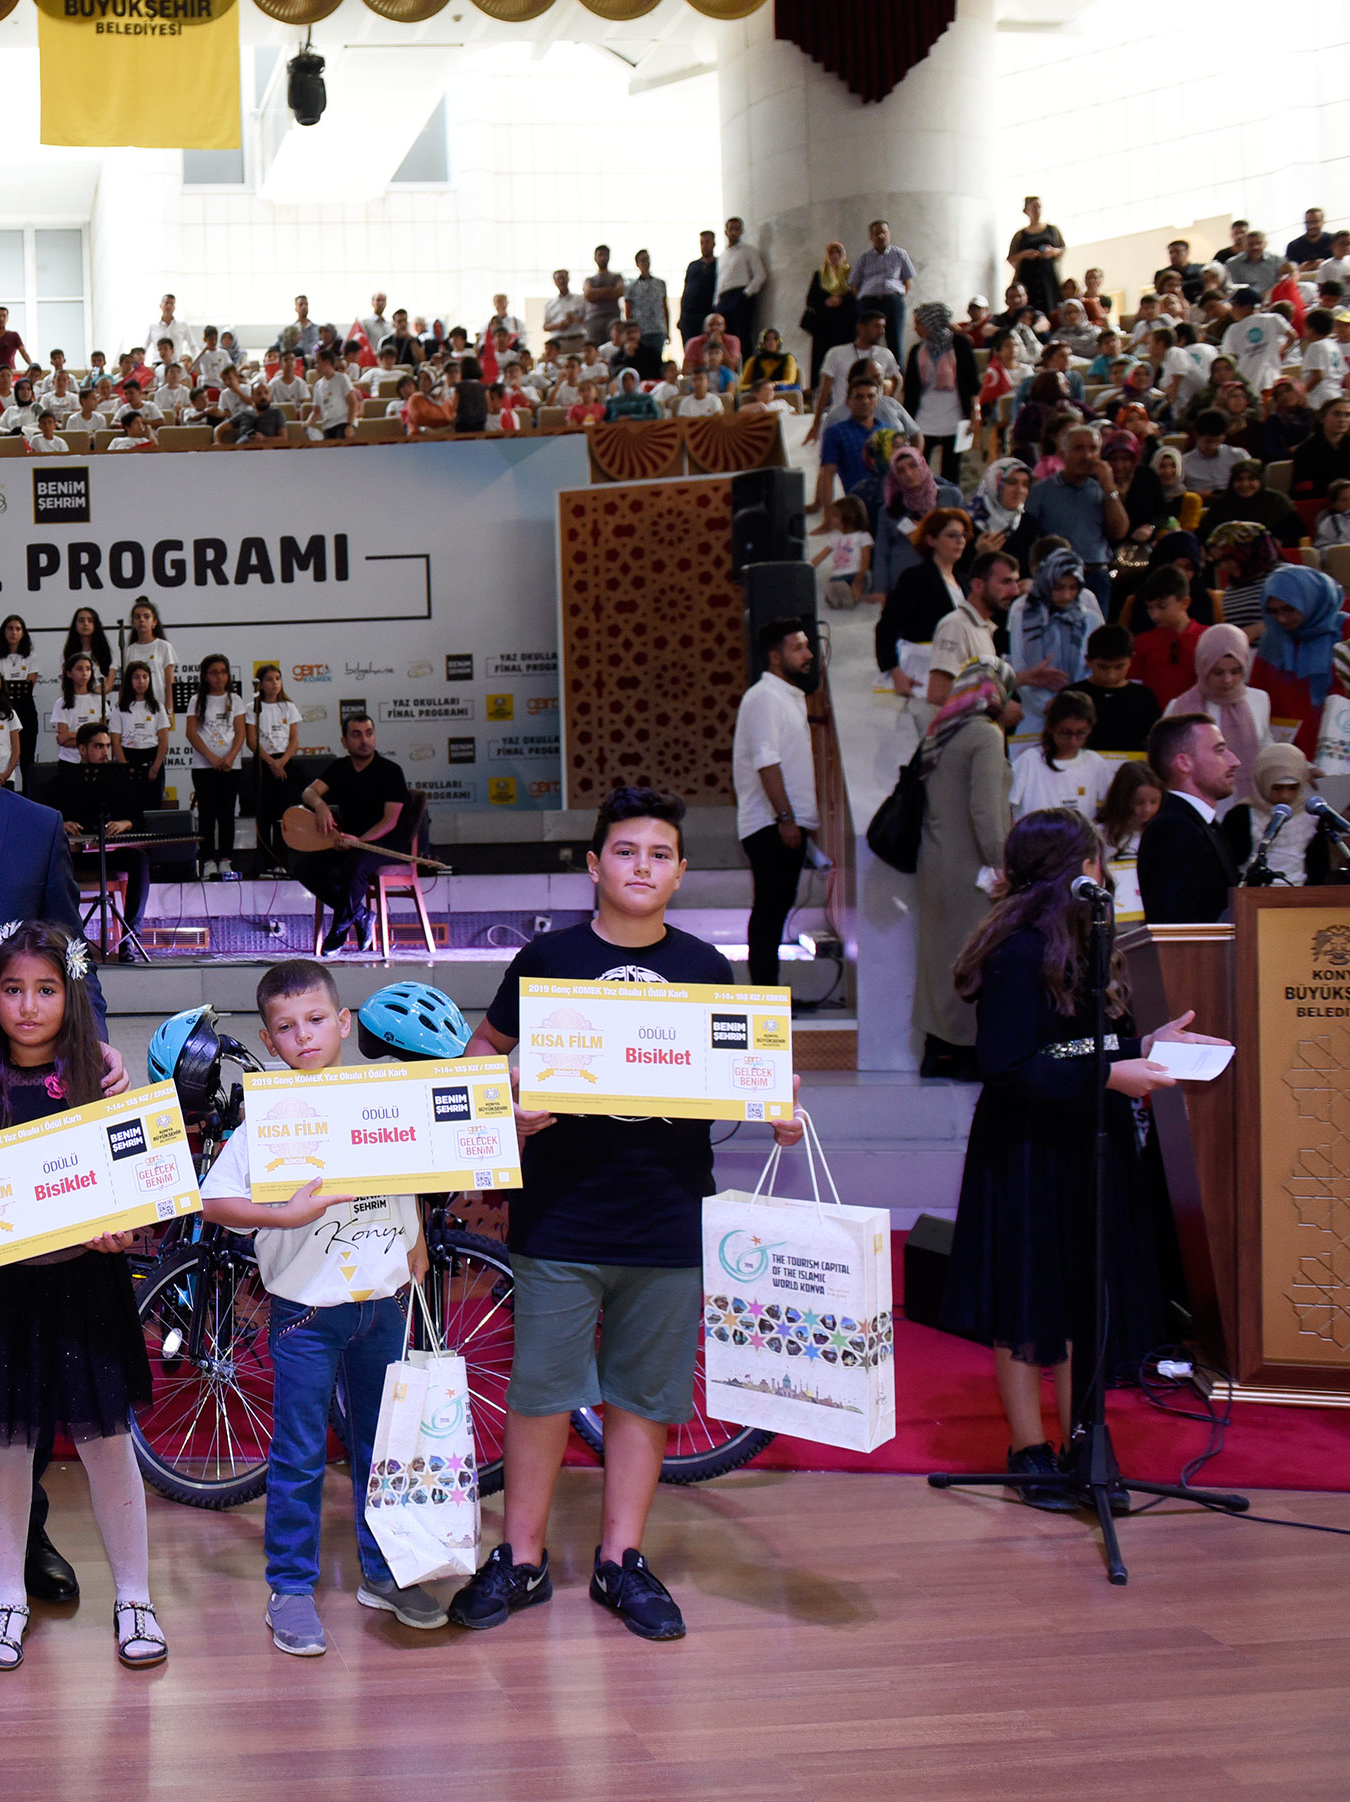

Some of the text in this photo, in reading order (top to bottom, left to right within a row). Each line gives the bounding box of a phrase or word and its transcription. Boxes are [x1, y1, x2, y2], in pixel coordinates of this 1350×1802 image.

[25, 533, 351, 592] PROGRAMI
[529, 984, 549, 992] 2019
[551, 985, 571, 995] Genç
[573, 986, 601, 994] KOMEK
[603, 987, 616, 995] Yaz
[531, 1032, 602, 1049] KISA FİLM
[638, 1025, 675, 1040] ÖDÜLÜ
[625, 1047, 691, 1065] Bisiklet
[252, 1067, 407, 1086] 2019 Genç KOMEK Yaz Okulu Ödül Kartı
[454, 1065, 467, 1073] YAŞ
[735, 1067, 772, 1077] GELECEK
[125, 1097, 138, 1107] YAŞ
[361, 1105, 399, 1120] ÖDÜLÜ
[3, 1132, 16, 1143] Yaz
[17, 1125, 39, 1138] Okulu
[44, 1116, 61, 1130] Ödül
[62, 1112, 81, 1125] Kartı
[257, 1118, 328, 1138] KISA FİLM
[350, 1125, 416, 1144] Bisiklet
[459, 1136, 497, 1146] GELECEK
[41, 1152, 78, 1174] ÖDÜLÜ
[138, 1162, 175, 1180] GELECEK
[34, 1169, 97, 1201] Bisiklet
[772, 1253, 851, 1275] THE TOURISM CAPITAL
[772, 1266, 827, 1283] OF THE ISLAMIC
[772, 1278, 799, 1291] WORLD
